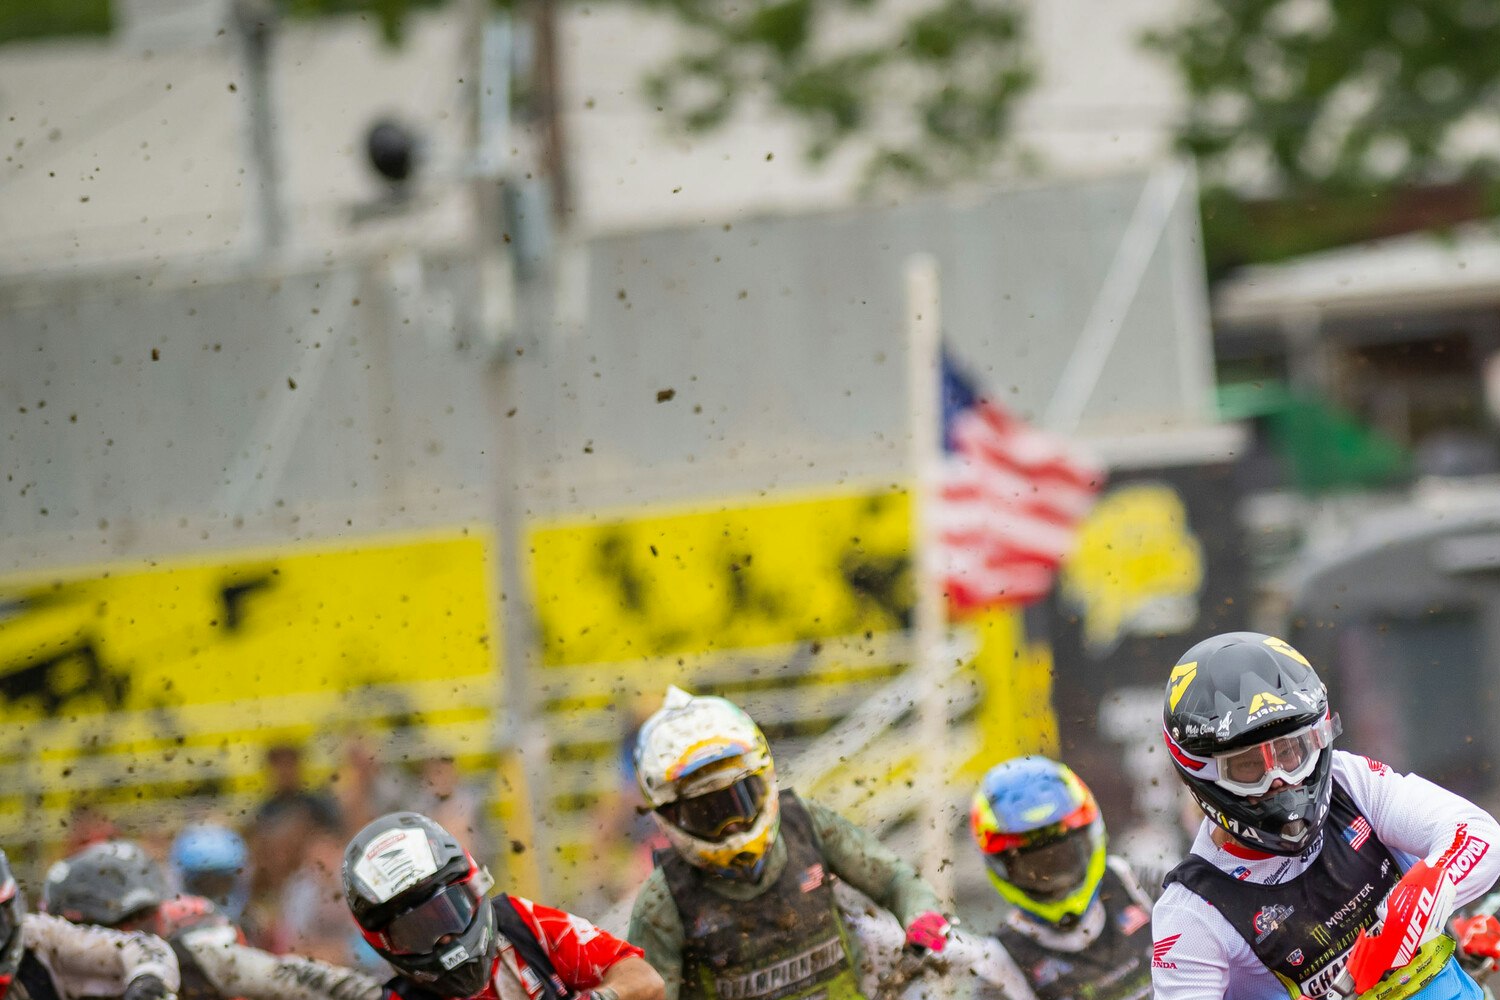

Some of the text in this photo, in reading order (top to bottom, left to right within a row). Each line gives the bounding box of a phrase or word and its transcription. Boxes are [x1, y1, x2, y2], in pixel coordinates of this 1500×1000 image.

[1247, 703, 1297, 725] ARMA
[1325, 883, 1374, 929] MONSTER
[1401, 887, 1434, 955] UFO
